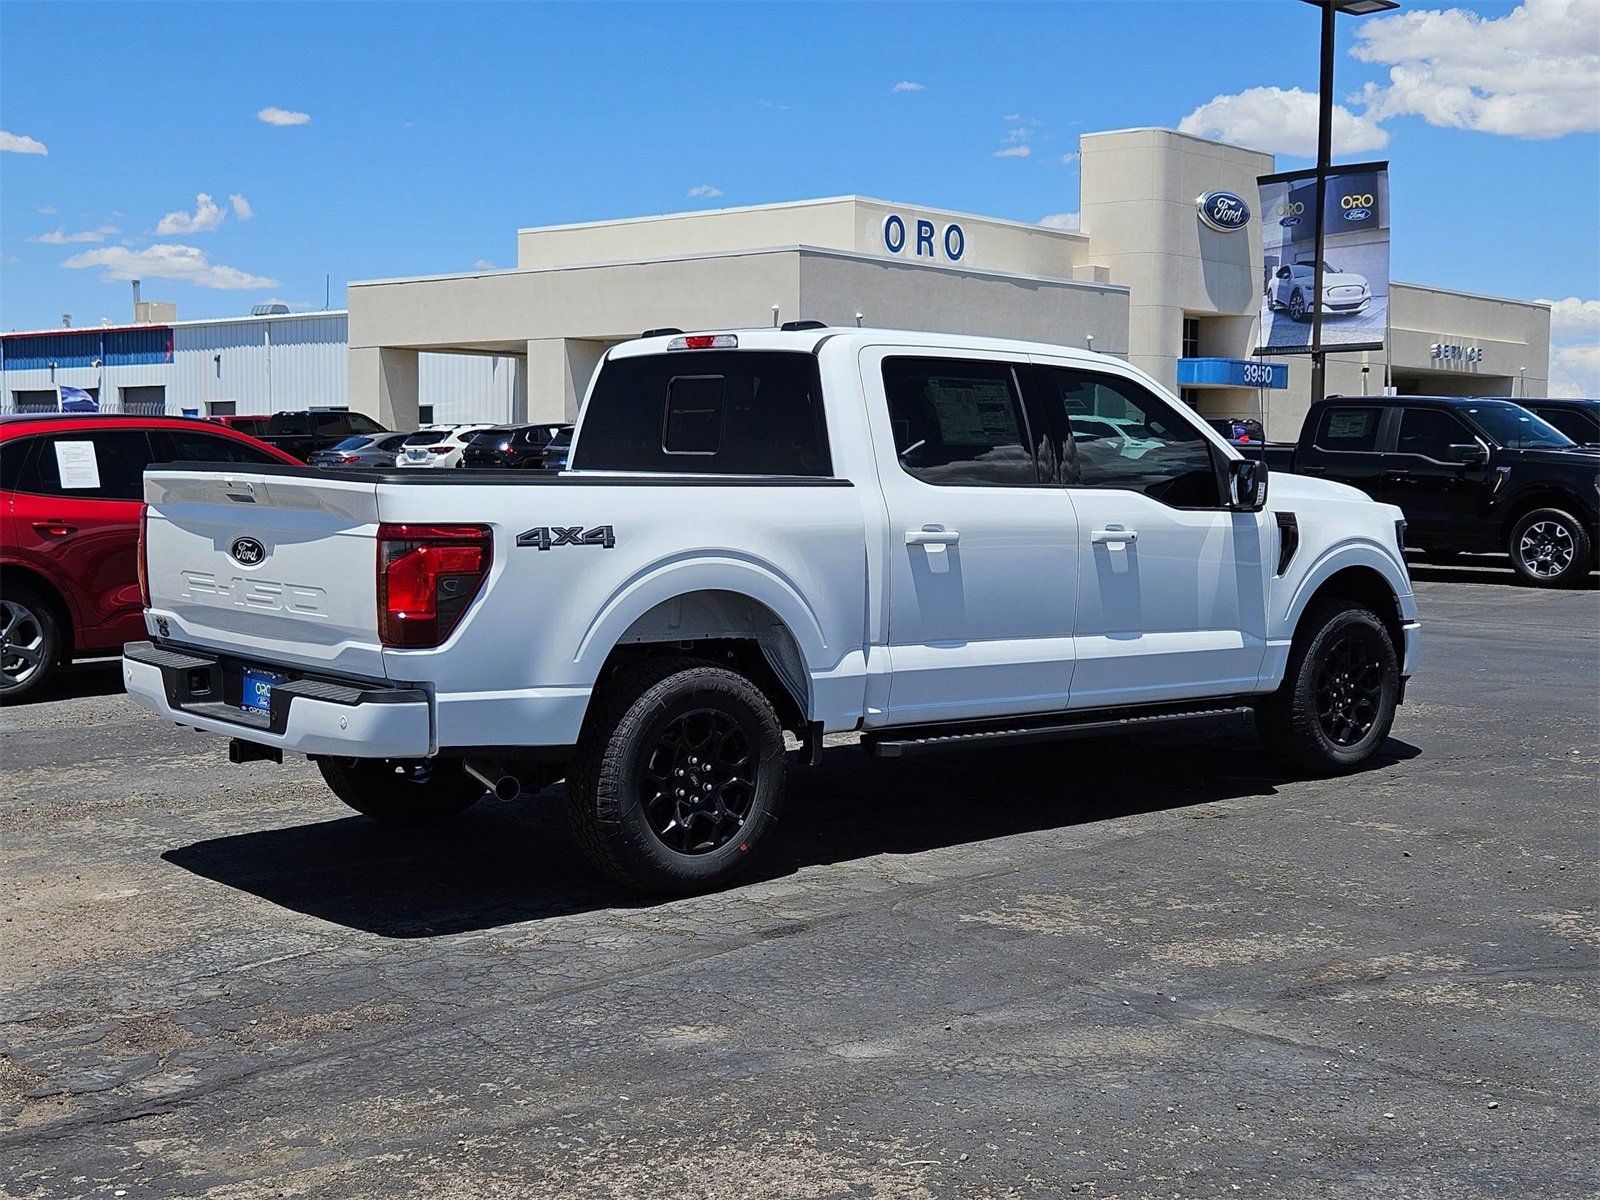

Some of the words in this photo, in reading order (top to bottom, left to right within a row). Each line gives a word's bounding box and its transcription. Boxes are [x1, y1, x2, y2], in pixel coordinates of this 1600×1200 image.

[1213, 197, 1243, 223] Ford
[1276, 202, 1304, 216] ORO
[1341, 194, 1373, 209] ORO
[1283, 218, 1299, 227] Ford
[1348, 210, 1365, 219] Ford
[883, 214, 965, 261] ORO
[1431, 344, 1482, 362] SERVICE
[1243, 364, 1273, 383] 3950
[235, 541, 258, 561] Ford
[180, 569, 329, 618] F-150
